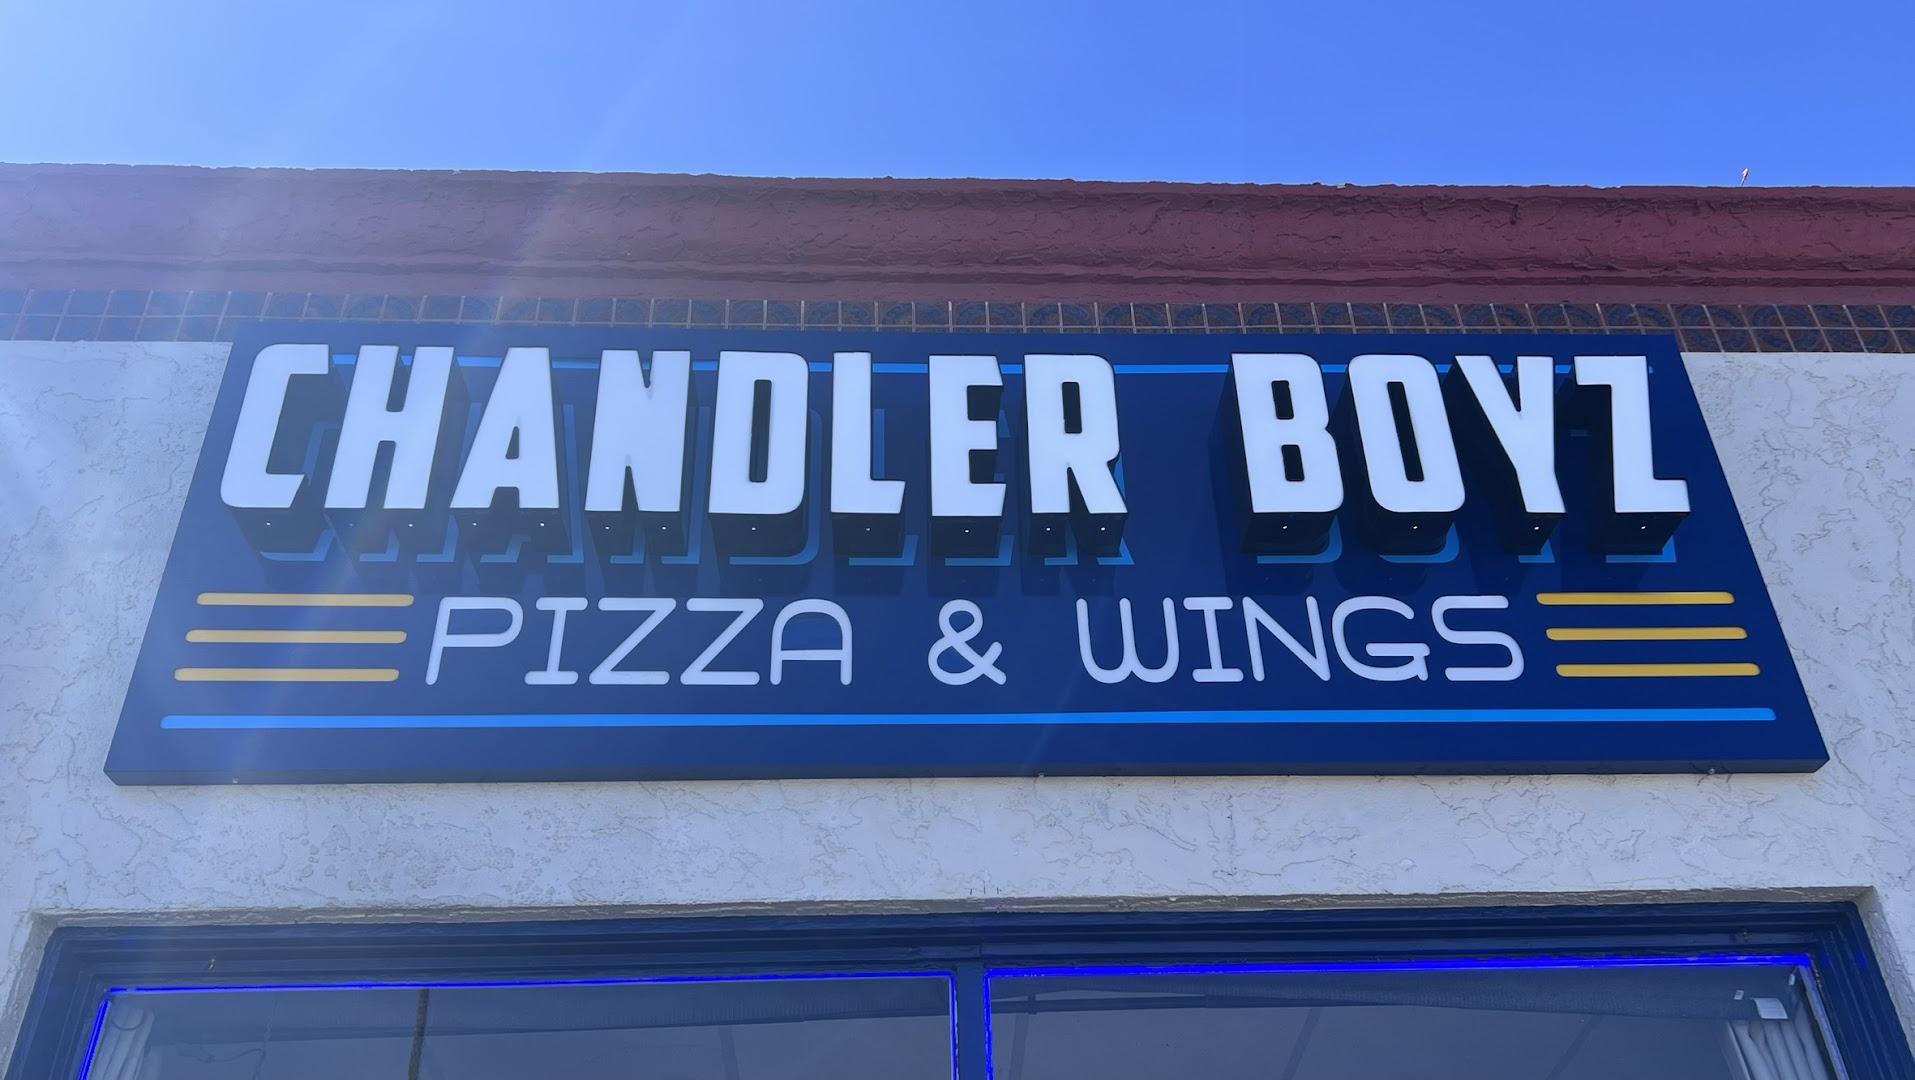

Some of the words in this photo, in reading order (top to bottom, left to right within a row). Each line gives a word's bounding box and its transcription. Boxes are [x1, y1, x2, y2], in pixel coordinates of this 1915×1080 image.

[220, 343, 1128, 517] CHANDLER
[1231, 353, 1690, 514] BOYZ
[425, 597, 853, 686] PIZZA
[928, 599, 1007, 686] &
[1076, 595, 1525, 684] WINGS
